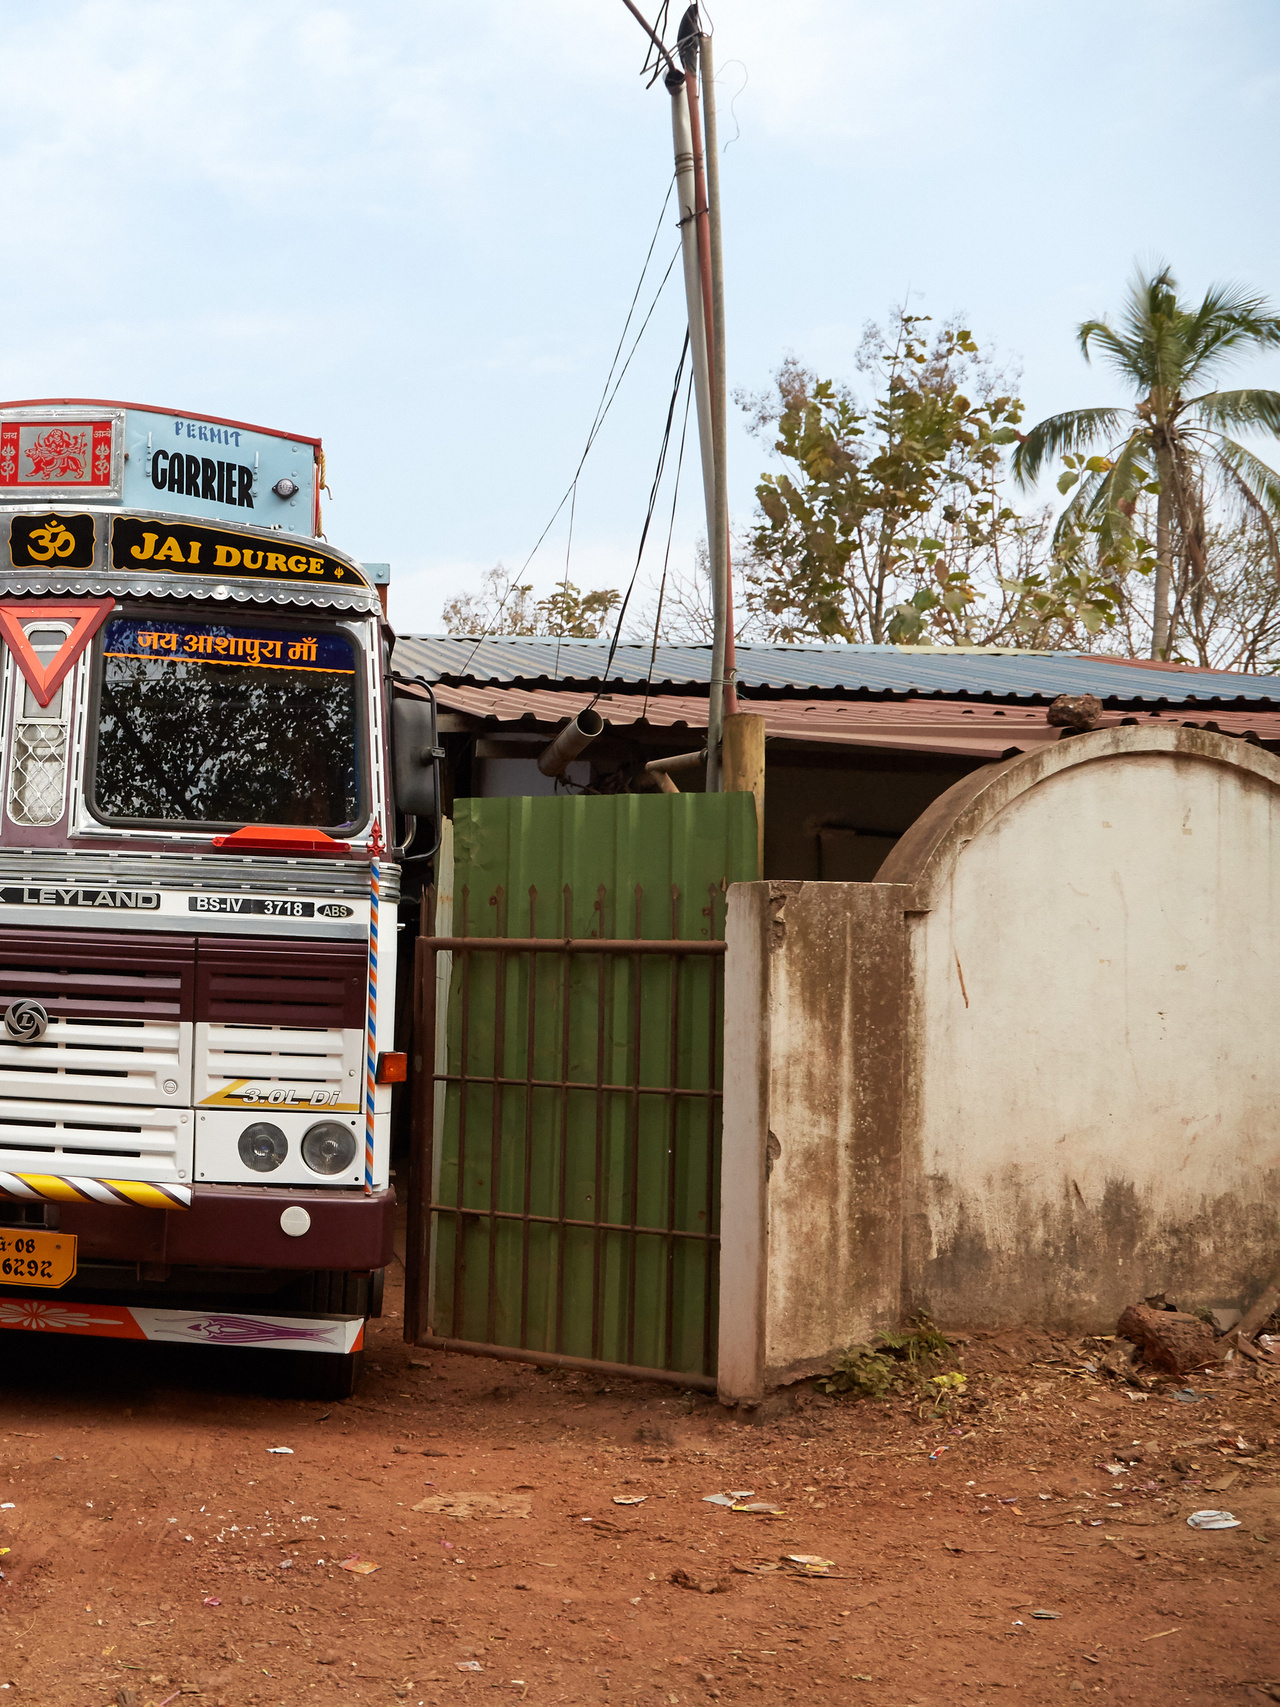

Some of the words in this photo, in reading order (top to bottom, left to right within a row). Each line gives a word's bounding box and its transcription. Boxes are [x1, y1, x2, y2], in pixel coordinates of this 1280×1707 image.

[174, 420, 243, 448] PERMIT
[151, 449, 255, 509] CARRIER
[130, 532, 202, 564] JAI
[214, 545, 324, 575] DURGE
[137, 631, 179, 650] जय
[183, 633, 282, 664] आशापुरा
[287, 636, 319, 662] माँ
[23, 887, 158, 908] LEYLAND
[196, 896, 244, 913] BS-IV
[263, 900, 303, 917] 3718
[323, 904, 348, 918] ABS
[242, 1087, 304, 1106] 3.0L
[309, 1089, 342, 1107] Di
